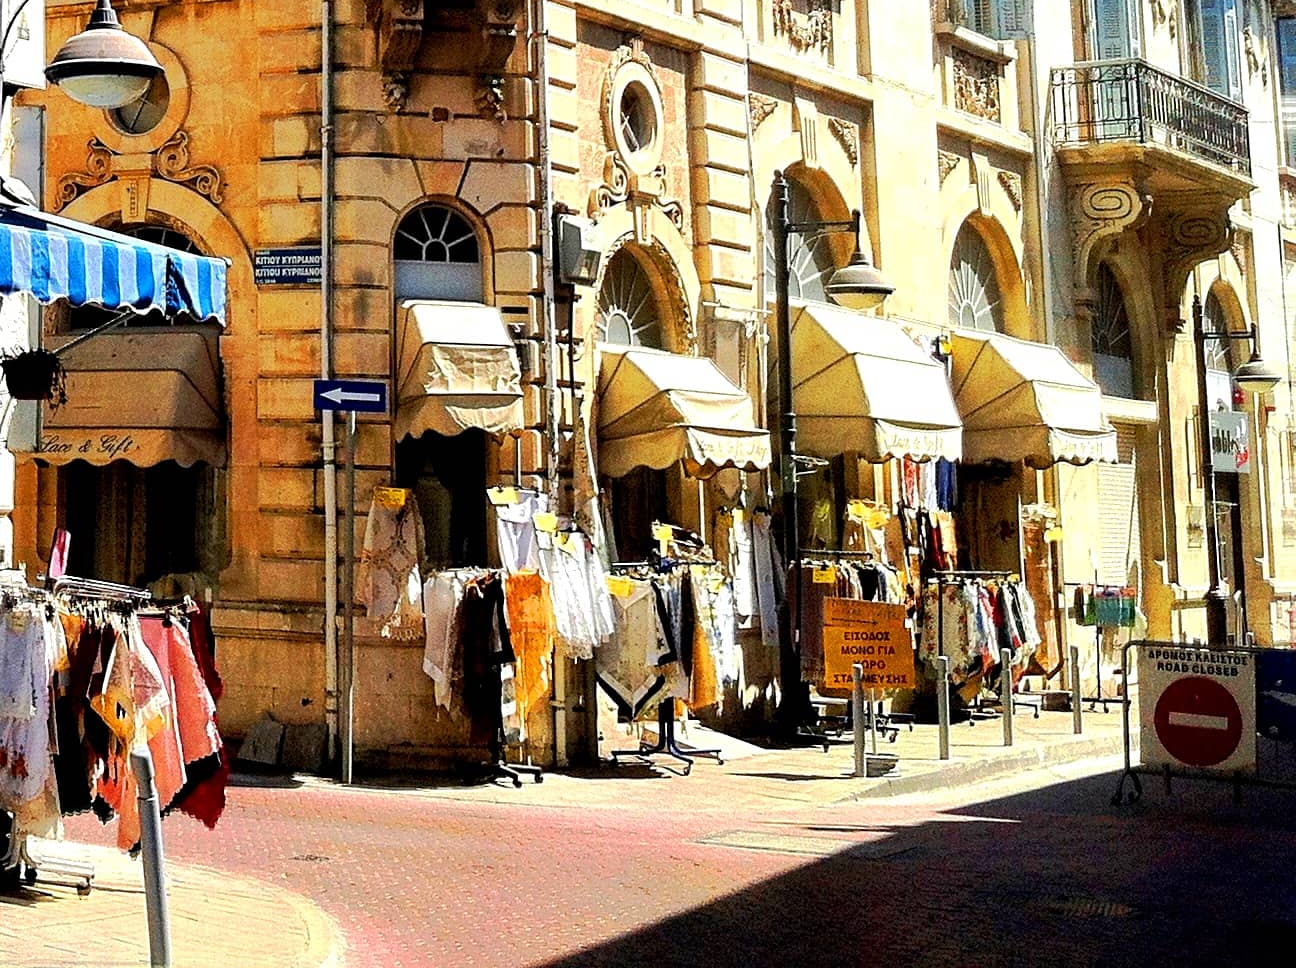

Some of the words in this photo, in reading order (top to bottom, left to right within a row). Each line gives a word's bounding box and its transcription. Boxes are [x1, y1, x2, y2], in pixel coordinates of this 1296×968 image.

[78, 439, 92, 453] &
[96, 434, 134, 459] Gift
[843, 631, 891, 641] ΕΙΣΟΔΟΣ
[840, 646, 875, 655] ΜΟΝΟ
[877, 646, 896, 655] ΓΙΑ
[1148, 650, 1193, 662] ΔΡΟΜΟΣ
[1195, 652, 1248, 666] ΚΛΕΙΣΤΟΣ
[1156, 661, 1190, 674] ROAD
[1191, 664, 1239, 677] CLOSED
[833, 673, 908, 684] ΣΤΑΜΕΥΣΗΣ
